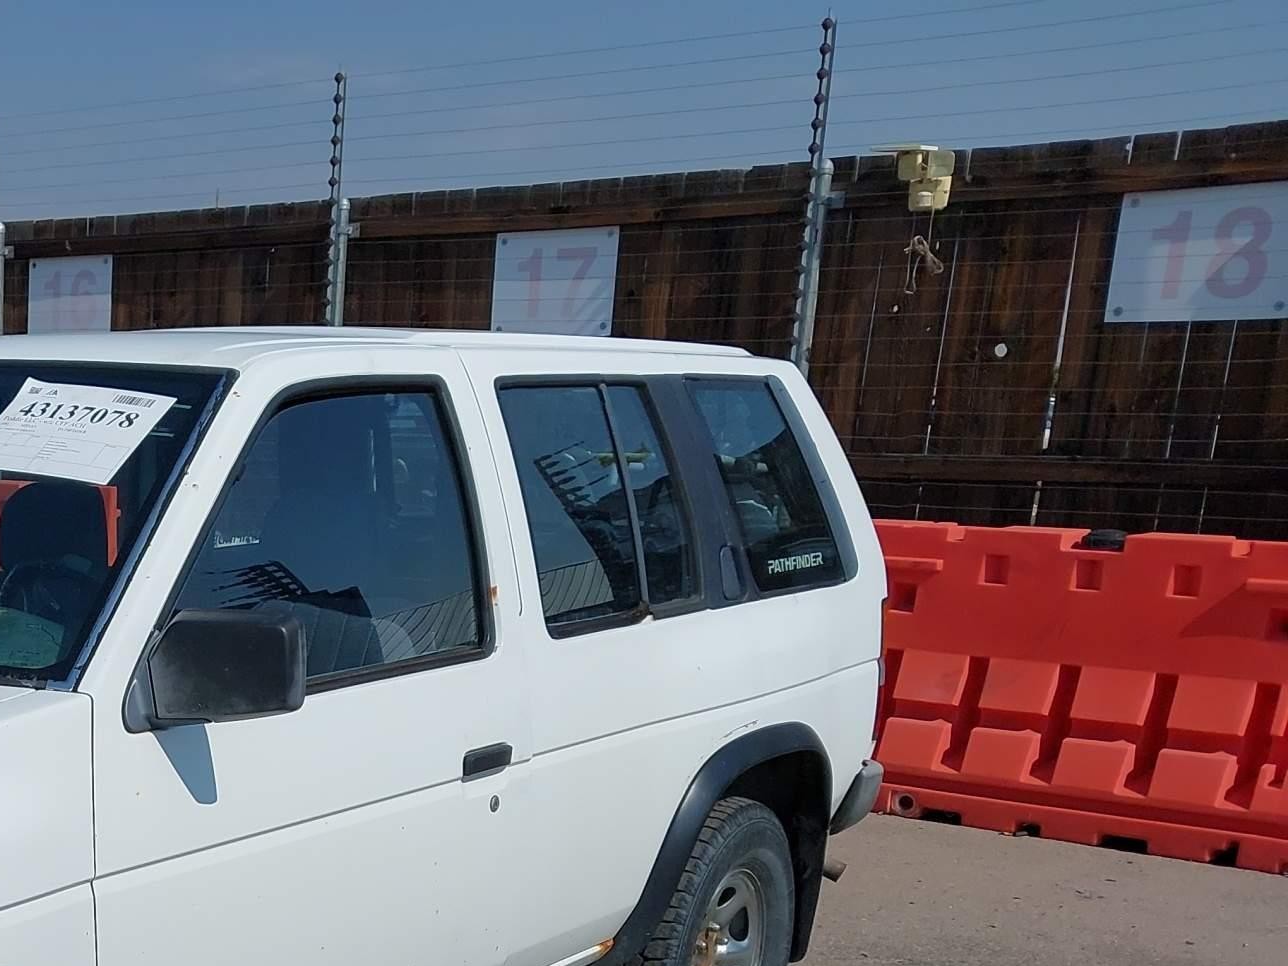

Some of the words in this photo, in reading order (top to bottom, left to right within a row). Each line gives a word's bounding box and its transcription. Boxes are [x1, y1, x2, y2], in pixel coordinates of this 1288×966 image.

[516, 246, 598, 320] 17
[1151, 206, 1273, 300] 18
[43, 269, 98, 330] 16
[19, 401, 140, 429] 43137078
[767, 551, 825, 575] PATHFINDER
